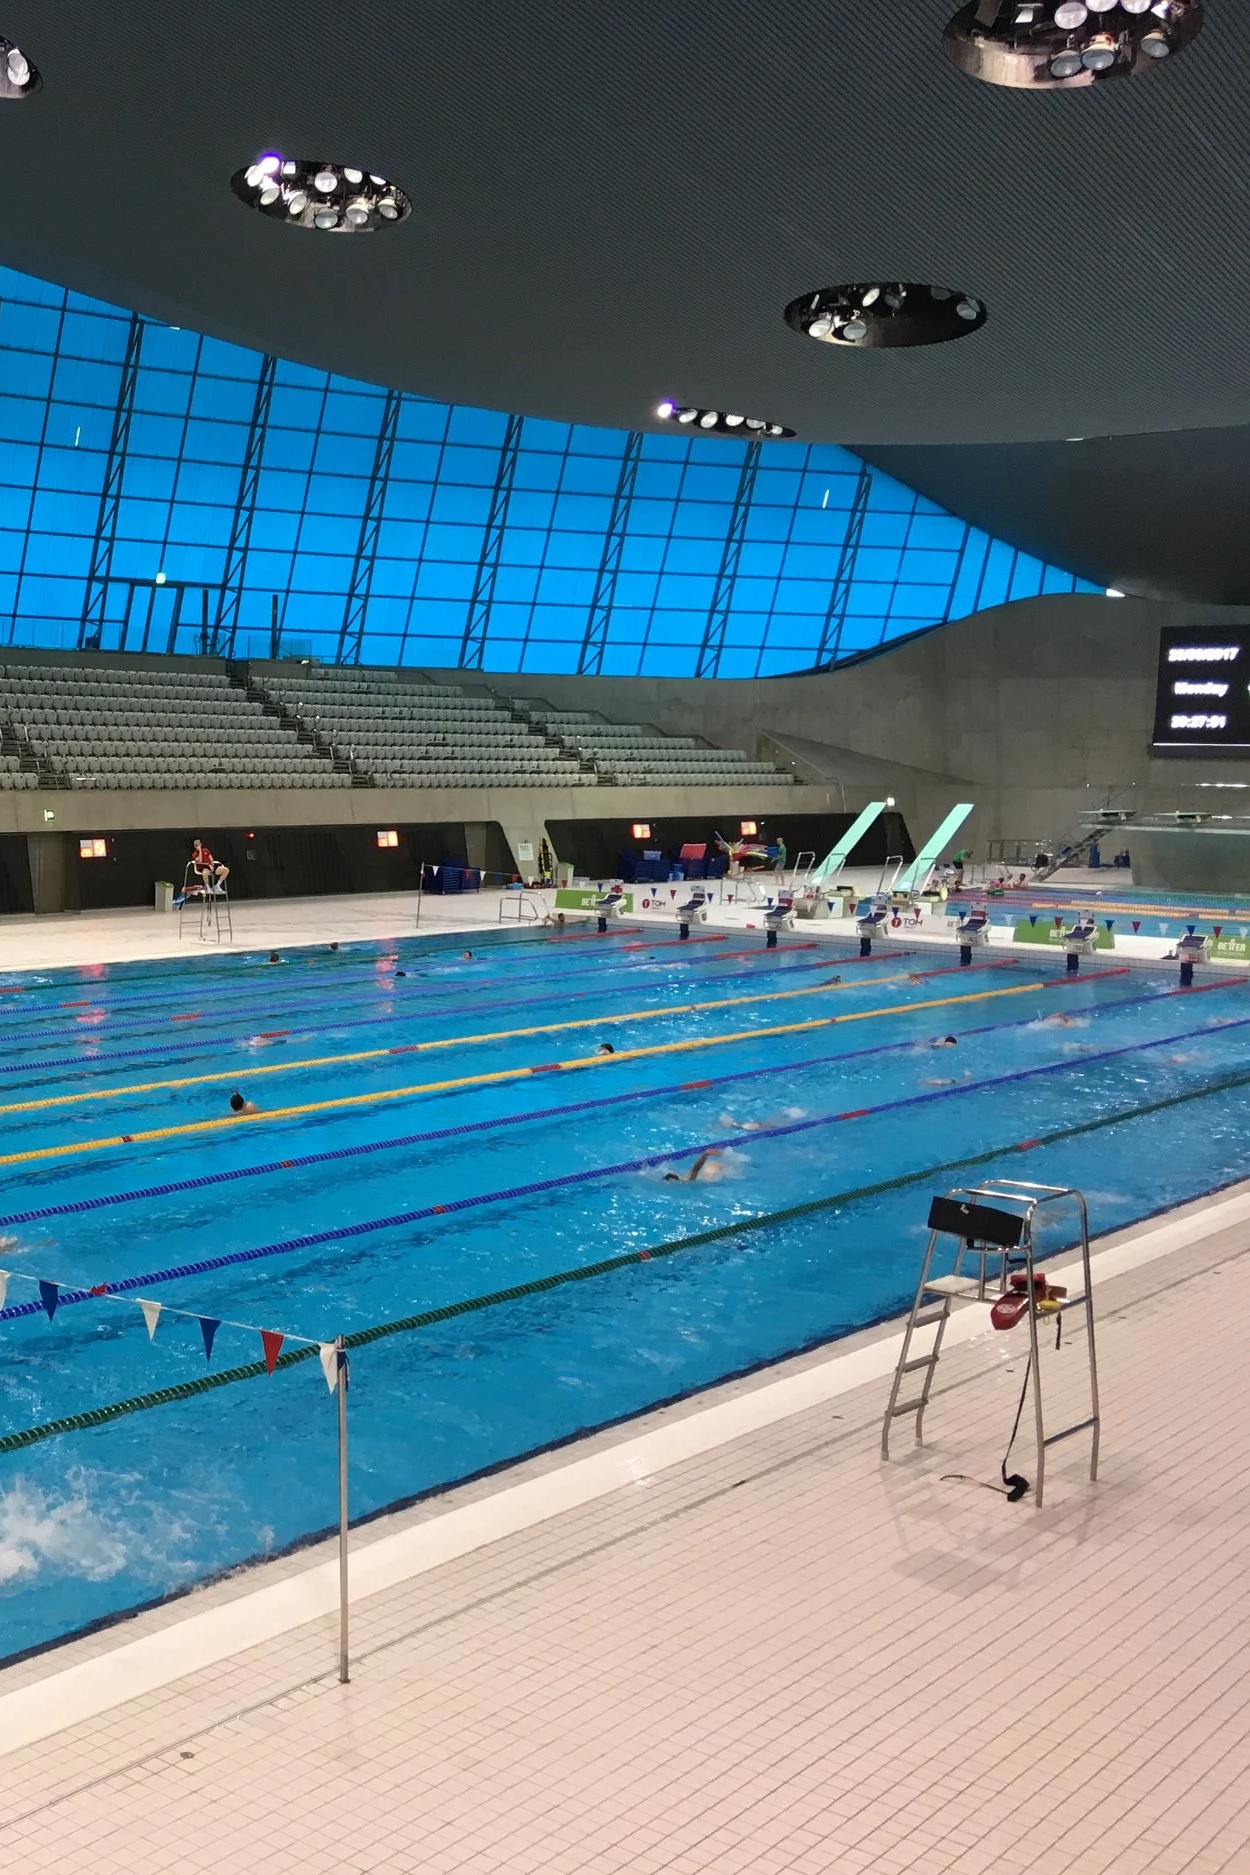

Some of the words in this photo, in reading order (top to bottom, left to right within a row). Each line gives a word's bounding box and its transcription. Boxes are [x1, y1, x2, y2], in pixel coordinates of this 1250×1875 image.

[651, 899, 667, 908] TOM
[903, 918, 924, 926] TOM
[1217, 939, 1247, 952] BETTER
